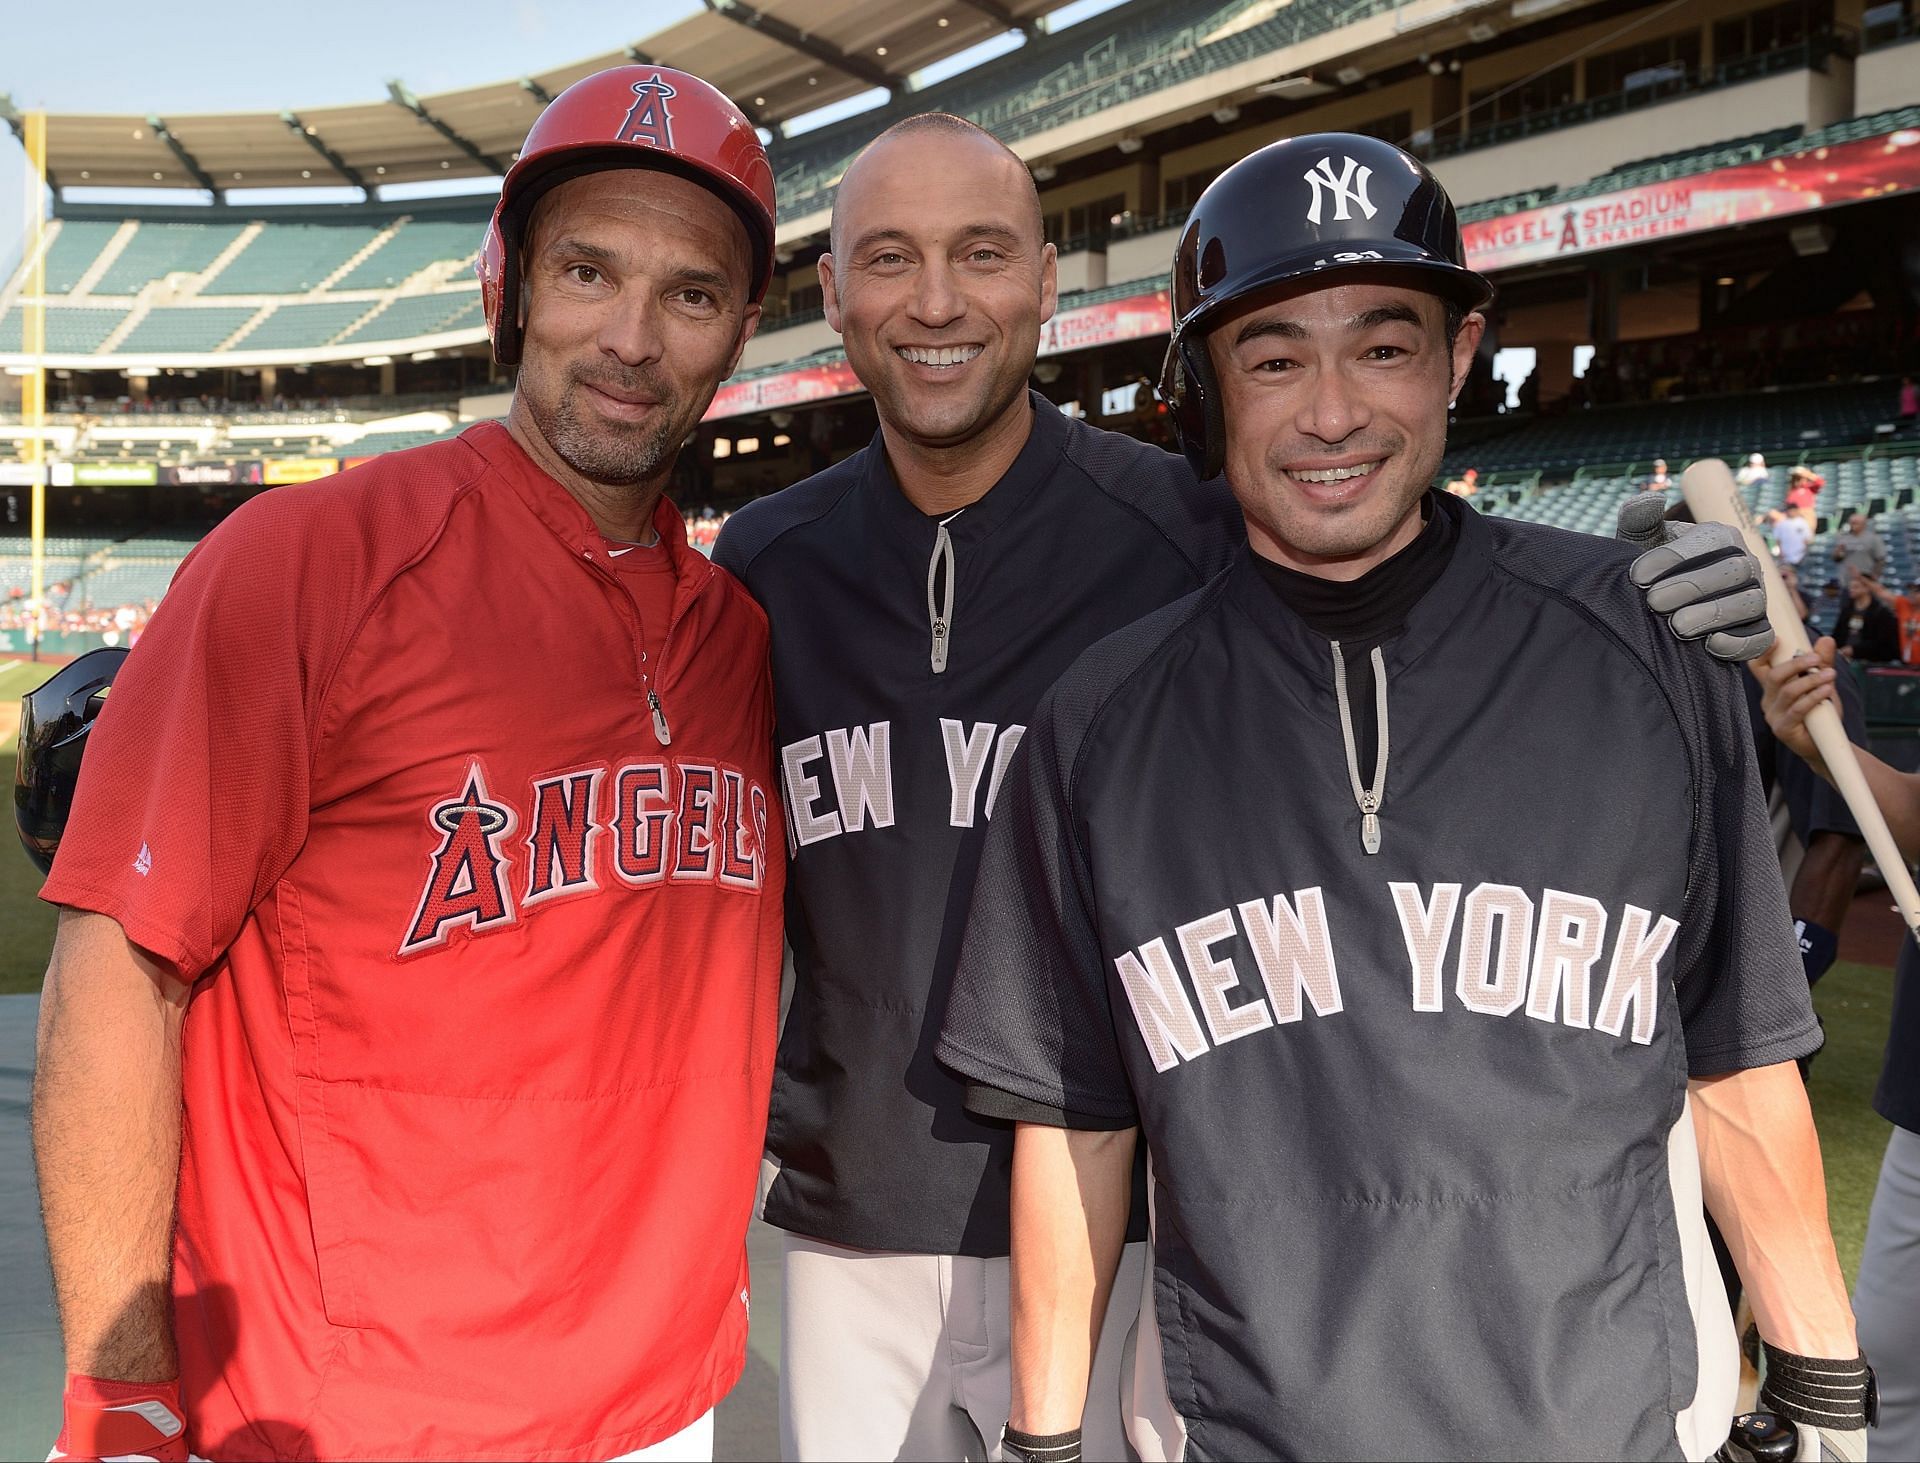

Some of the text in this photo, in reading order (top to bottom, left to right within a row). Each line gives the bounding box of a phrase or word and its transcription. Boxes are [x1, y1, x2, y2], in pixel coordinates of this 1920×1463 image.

[1463, 217, 1555, 251] ANGEL
[1584, 188, 1692, 230] STADIUM
[1584, 216, 1688, 246] ANAHEIM
[780, 720, 895, 860] EW
[1114, 882, 1680, 1073] NEW YORK
